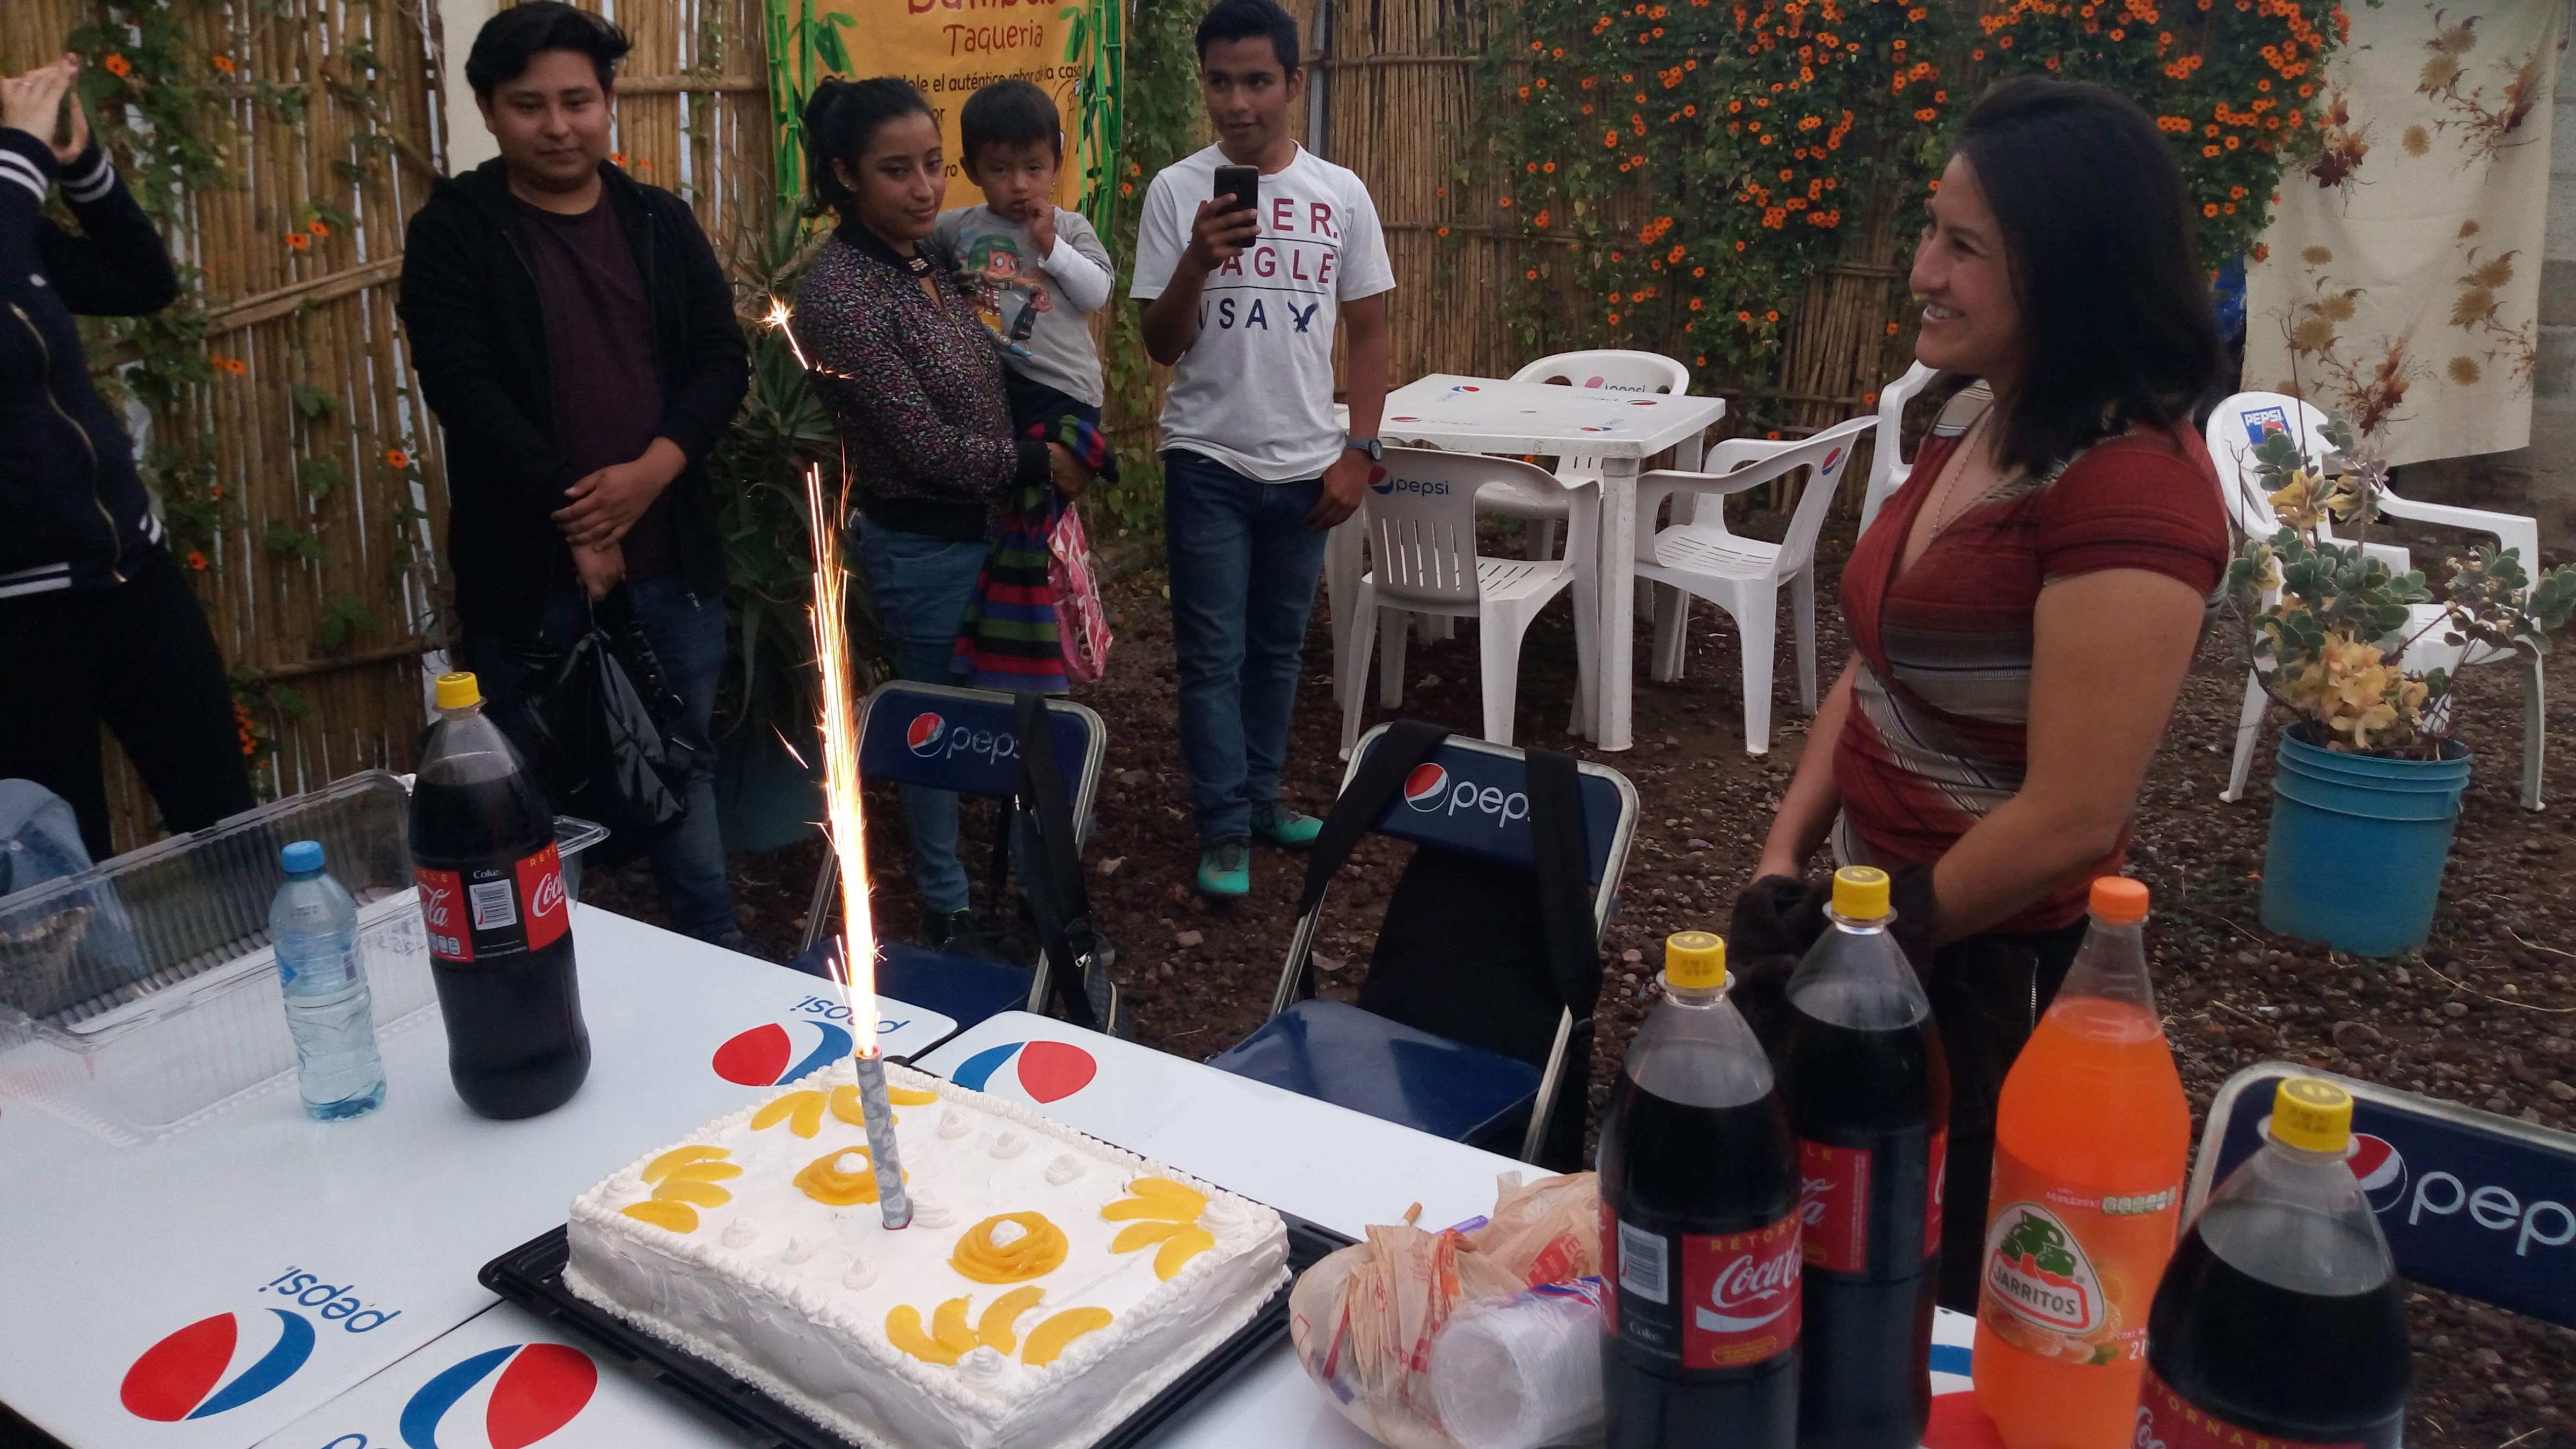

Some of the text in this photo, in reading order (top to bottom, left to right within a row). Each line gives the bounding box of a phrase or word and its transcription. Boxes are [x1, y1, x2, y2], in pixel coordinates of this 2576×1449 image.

[943, 19, 1043, 56] Taqueria
[933, 74, 945, 92] el
[1191, 198, 1338, 239] ER.
[1208, 246, 1334, 284] AGLE
[2244, 408, 2283, 427] PEPSI
[1396, 479, 1449, 497] pepsi
[946, 726, 1020, 765] pep
[1447, 780, 1531, 828] pep
[473, 869, 500, 879] Coke
[789, 996, 911, 1034] ppsi
[2409, 1170, 2576, 1257] pep
[258, 1268, 402, 1334] pepsi
[1993, 1266, 2077, 1316] JARRITOS
